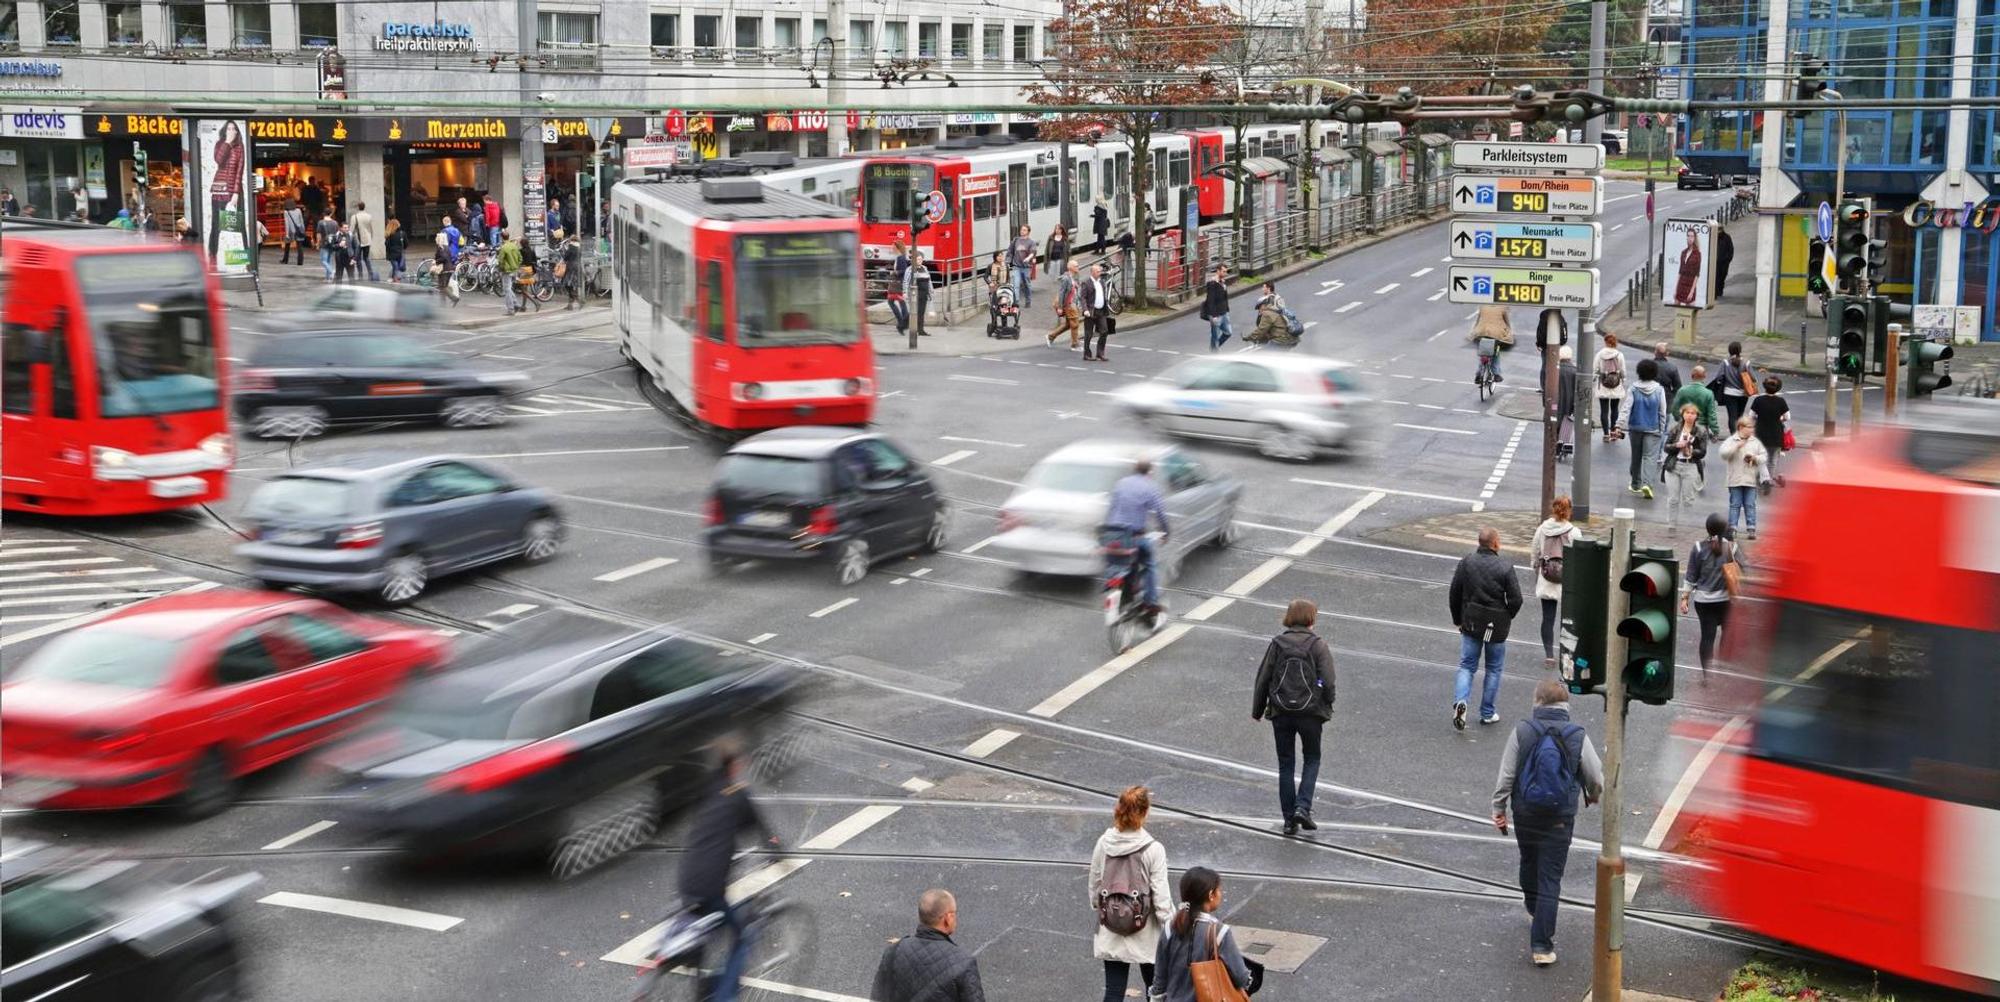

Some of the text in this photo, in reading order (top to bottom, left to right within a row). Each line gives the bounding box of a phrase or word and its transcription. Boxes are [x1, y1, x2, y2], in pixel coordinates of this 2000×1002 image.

[386, 19, 474, 38] paracelsus
[376, 36, 481, 53] heilpraktikerschule
[0, 60, 61, 76] aracelsus
[250, 118, 315, 138] rzenich
[427, 119, 507, 138] Merzenich
[547, 130, 556, 141] 3
[1483, 148, 1567, 165] Parkleitsystem
[1521, 180, 1569, 191] Dom/Rhein
[1512, 194, 1544, 211] 940
[1552, 202, 1567, 210] freie
[1522, 226, 1564, 237] Neumarkt
[1667, 223, 1710, 235] MANGO
[1500, 239, 1543, 256] 1578
[1550, 248, 1565, 256] freie
[1529, 271, 1553, 283] Ringe
[1498, 285, 1541, 302] 1480
[1548, 294, 1563, 302] freie
